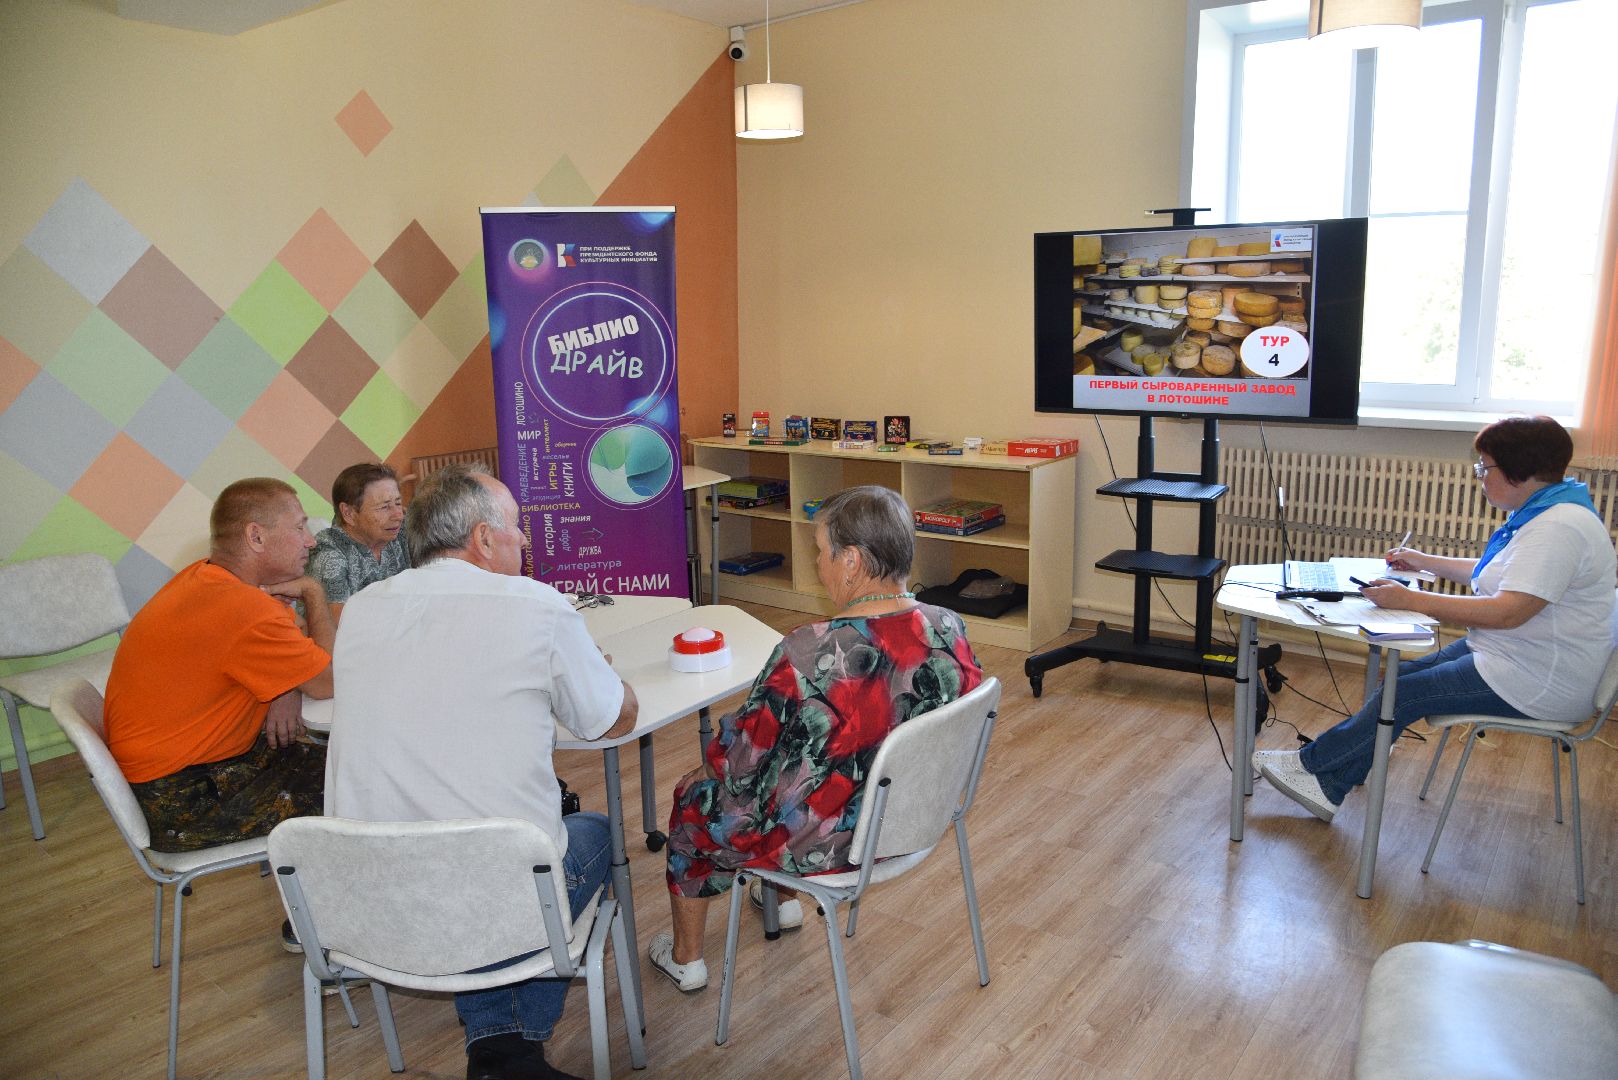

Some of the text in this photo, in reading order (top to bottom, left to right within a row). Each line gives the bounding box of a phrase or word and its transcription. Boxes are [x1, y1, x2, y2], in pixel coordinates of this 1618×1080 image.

[547, 314, 640, 356] БИБЛИО
[1259, 335, 1290, 347] ТУР
[550, 348, 644, 379] ДРАЙВ
[1268, 353, 1280, 367] 4
[1089, 379, 1296, 396] ПЕРВЫЙ СЫРОВАРЕННЫЙ ЗАВОД
[514, 381, 526, 426] ЛОТОШИНО
[1147, 394, 1229, 406] В ЛОТОШИНЕ
[517, 430, 542, 441] МИР
[543, 418, 551, 453] интеллект
[517, 443, 530, 503] КРАЕВЕДЕНИЕ
[532, 447, 540, 481] встреча
[548, 462, 559, 490] ИГРЫ
[562, 462, 575, 497] КНИГИ
[521, 502, 581, 513] БИБЛИОТЕКА
[560, 515, 591, 524] знания
[559, 529, 571, 552] добро
[578, 545, 602, 559] ДРУЖБА
[557, 560, 622, 571] литература
[603, 577, 613, 594] С
[618, 573, 670, 593] НАМИ
